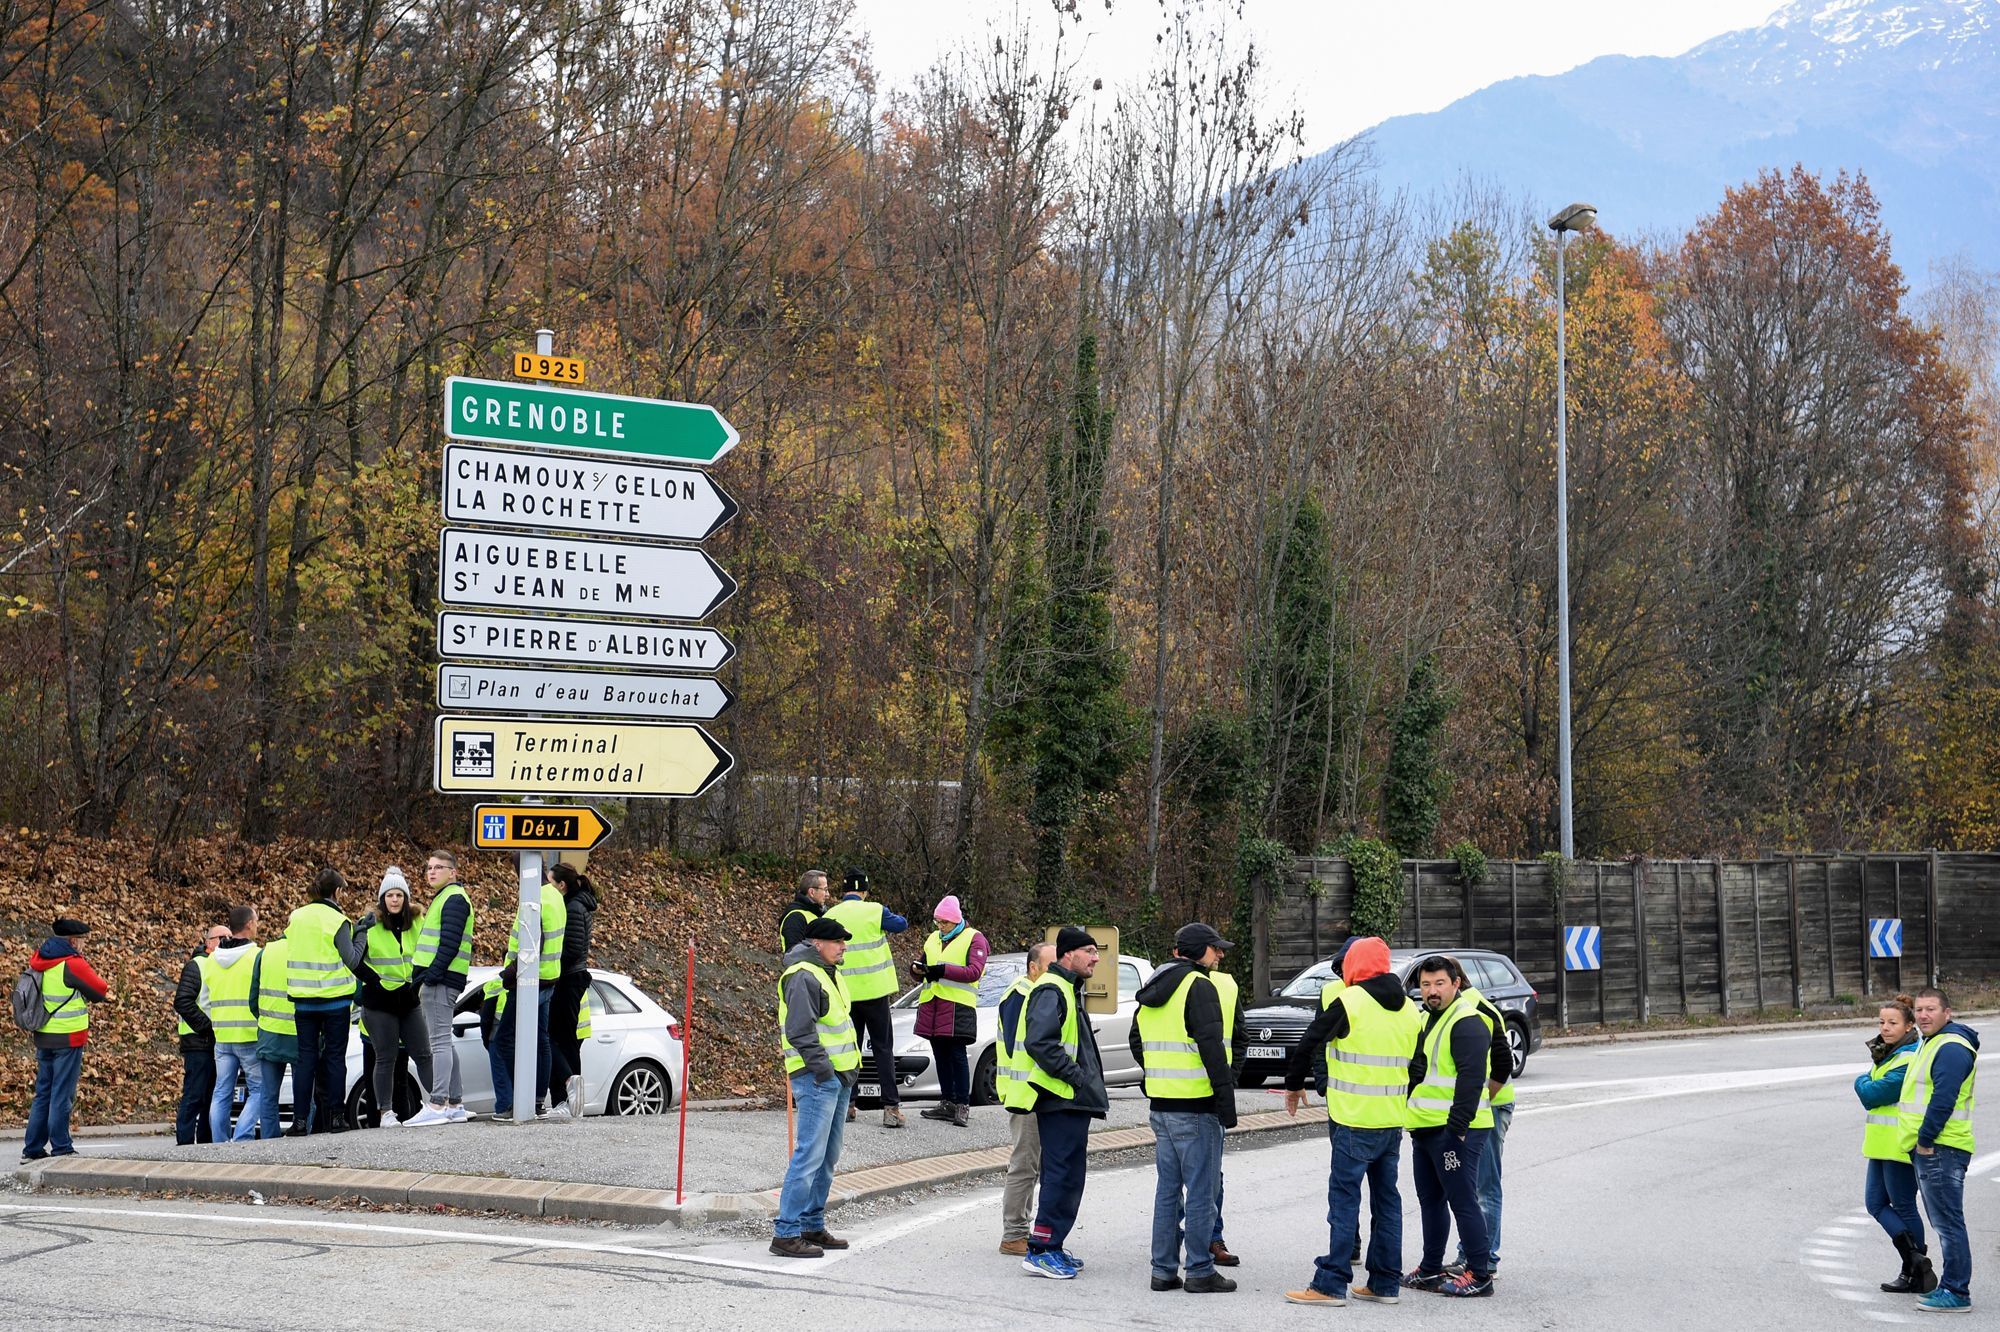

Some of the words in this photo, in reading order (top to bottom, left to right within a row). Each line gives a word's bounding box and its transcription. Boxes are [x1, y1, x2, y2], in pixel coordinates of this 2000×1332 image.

[521, 357, 532, 373] D
[539, 360, 579, 379] 925
[463, 396, 624, 438] GRENOBLE
[458, 460, 584, 490] CHAMOUX
[616, 475, 694, 500] GELON
[457, 488, 485, 510] LA
[503, 493, 639, 523] ROCHETTE
[455, 543, 626, 574] AIGUEBELLE
[494, 575, 563, 598] JEAN
[580, 588, 599, 600] DE
[487, 627, 576, 651] PIERRE
[477, 680, 519, 697] Plan
[536, 683, 588, 700] d'eau
[604, 686, 699, 705] Barouchat
[515, 732, 617, 753] Terminal
[511, 761, 643, 782] intermodal
[522, 819, 569, 836] Dév.1
[1445, 1161, 1461, 1170] OUT
